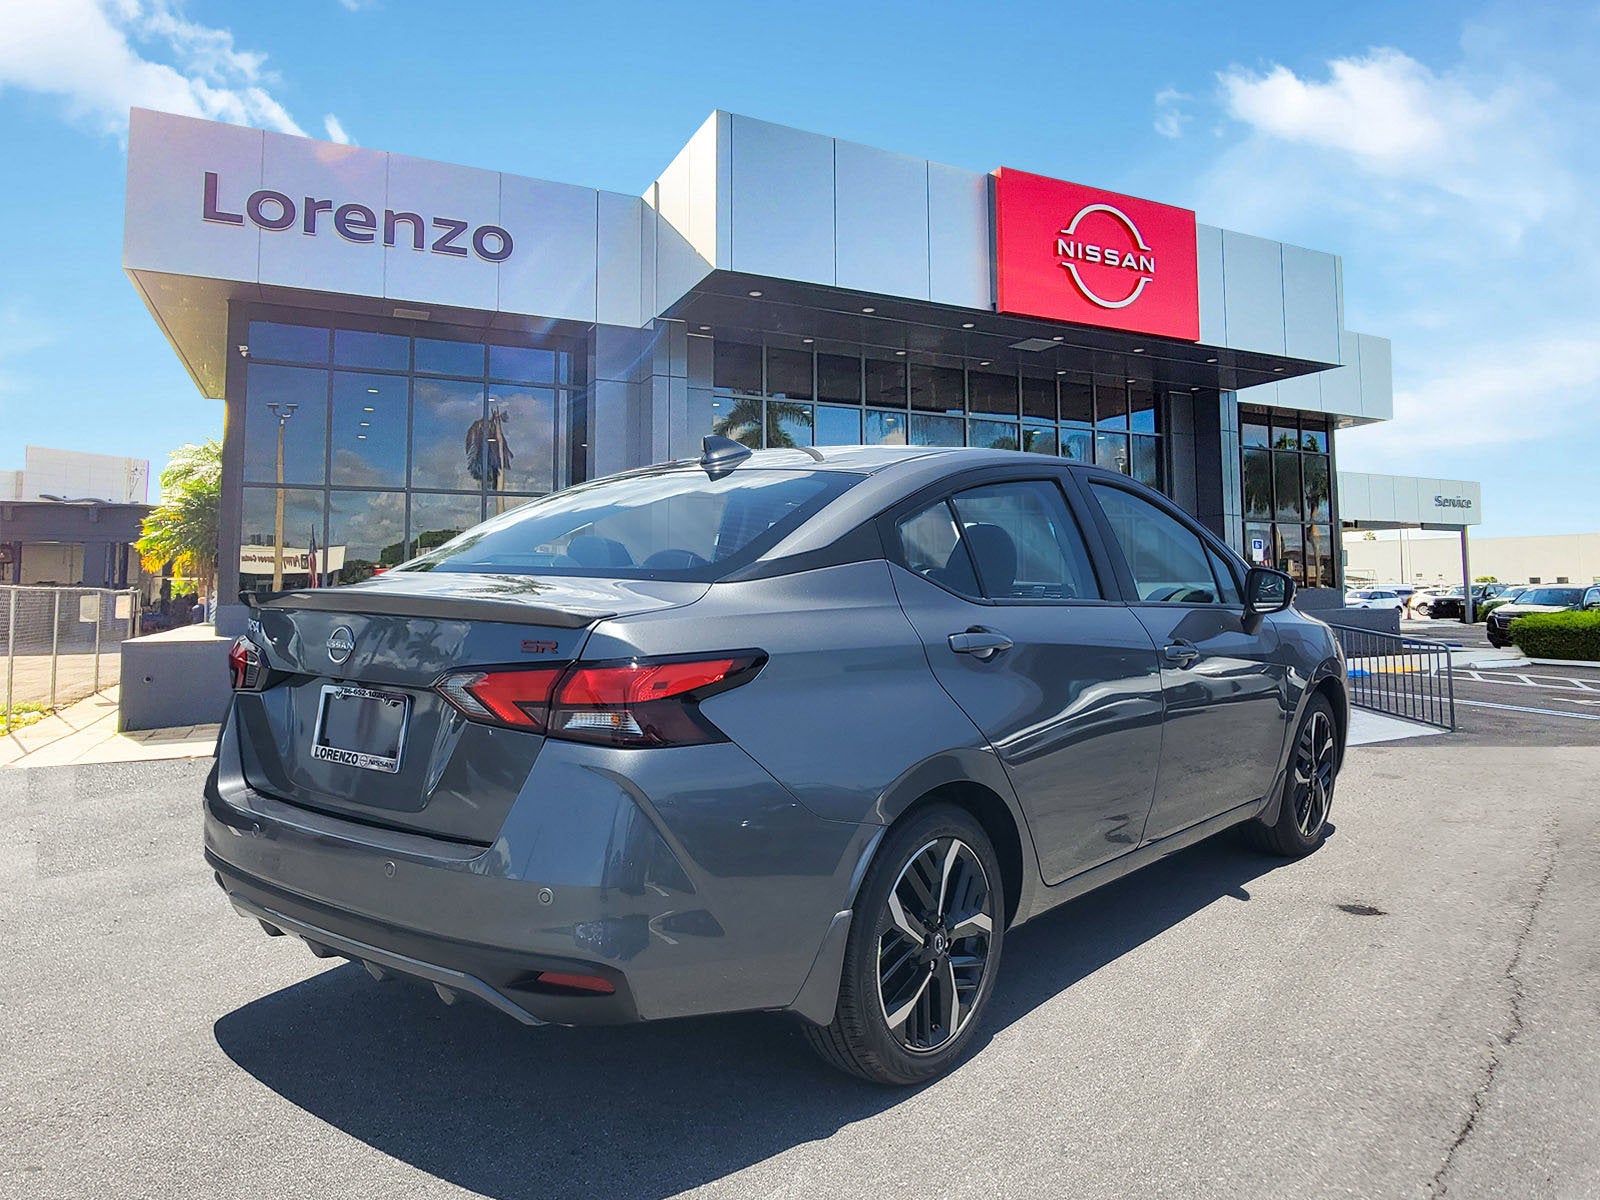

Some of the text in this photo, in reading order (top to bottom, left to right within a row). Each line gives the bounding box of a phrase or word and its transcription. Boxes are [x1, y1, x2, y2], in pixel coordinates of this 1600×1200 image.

[202, 171, 514, 262] Lorenzo
[1057, 238, 1155, 273] NISSAN
[1434, 495, 1472, 508] Service
[521, 639, 559, 654] SR
[314, 746, 395, 769] LORENZO NISSAN
